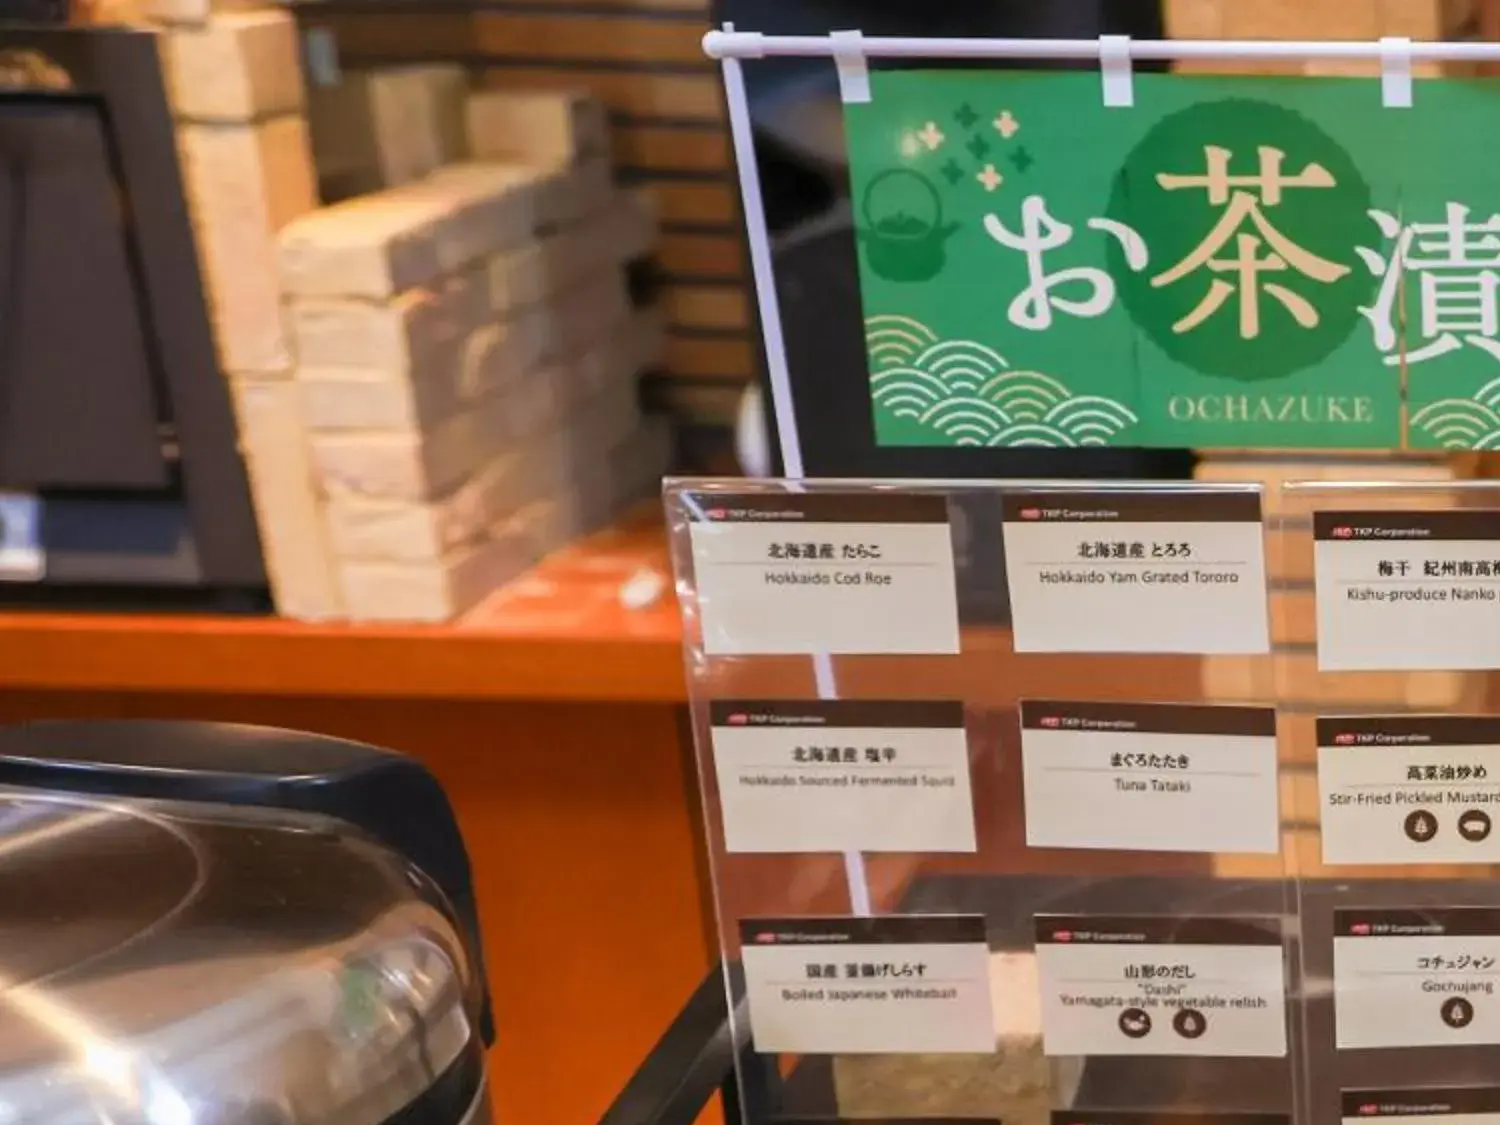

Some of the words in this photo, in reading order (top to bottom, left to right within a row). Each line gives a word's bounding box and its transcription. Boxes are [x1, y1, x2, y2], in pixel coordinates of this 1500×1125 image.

[1167, 394, 1374, 424] OCHAZUKE
[1373, 527, 1430, 537] Corporation
[769, 543, 834, 559] 北海道産
[843, 544, 880, 558] たらこ
[1079, 542, 1144, 558] 北海道産
[1152, 543, 1191, 557] とろろ
[1378, 561, 1412, 578] 梅干
[765, 573, 830, 584] Hokkaido
[834, 572, 861, 585] Cod
[865, 573, 892, 585] Roe
[1039, 572, 1105, 583] Hokkaido
[1109, 573, 1137, 583] Yam
[1142, 572, 1189, 583] Grated
[1195, 572, 1238, 583] Tororo
[1348, 590, 1447, 600] Kishu-produce
[1451, 589, 1495, 600] Nanko
[793, 747, 857, 762] 北海道産
[1111, 754, 1188, 768] まぐろたたき
[1407, 765, 1486, 780] 高菜油炒め
[739, 776, 796, 786] Hokkaido
[799, 777, 848, 786] Sourced
[851, 777, 918, 786] Fermented
[1115, 779, 1147, 791] Tuna
[1151, 780, 1191, 792] Tataki
[1330, 793, 1392, 805] Stir-Fried
[1395, 792, 1443, 804] Pickled
[1418, 956, 1495, 969] コチュジャン
[807, 964, 837, 979] 国産
[1124, 965, 1195, 979] 山形のだし
[1422, 982, 1493, 993] Gochujang
[782, 990, 824, 1001] Boiled
[828, 990, 887, 1000] Japanese
